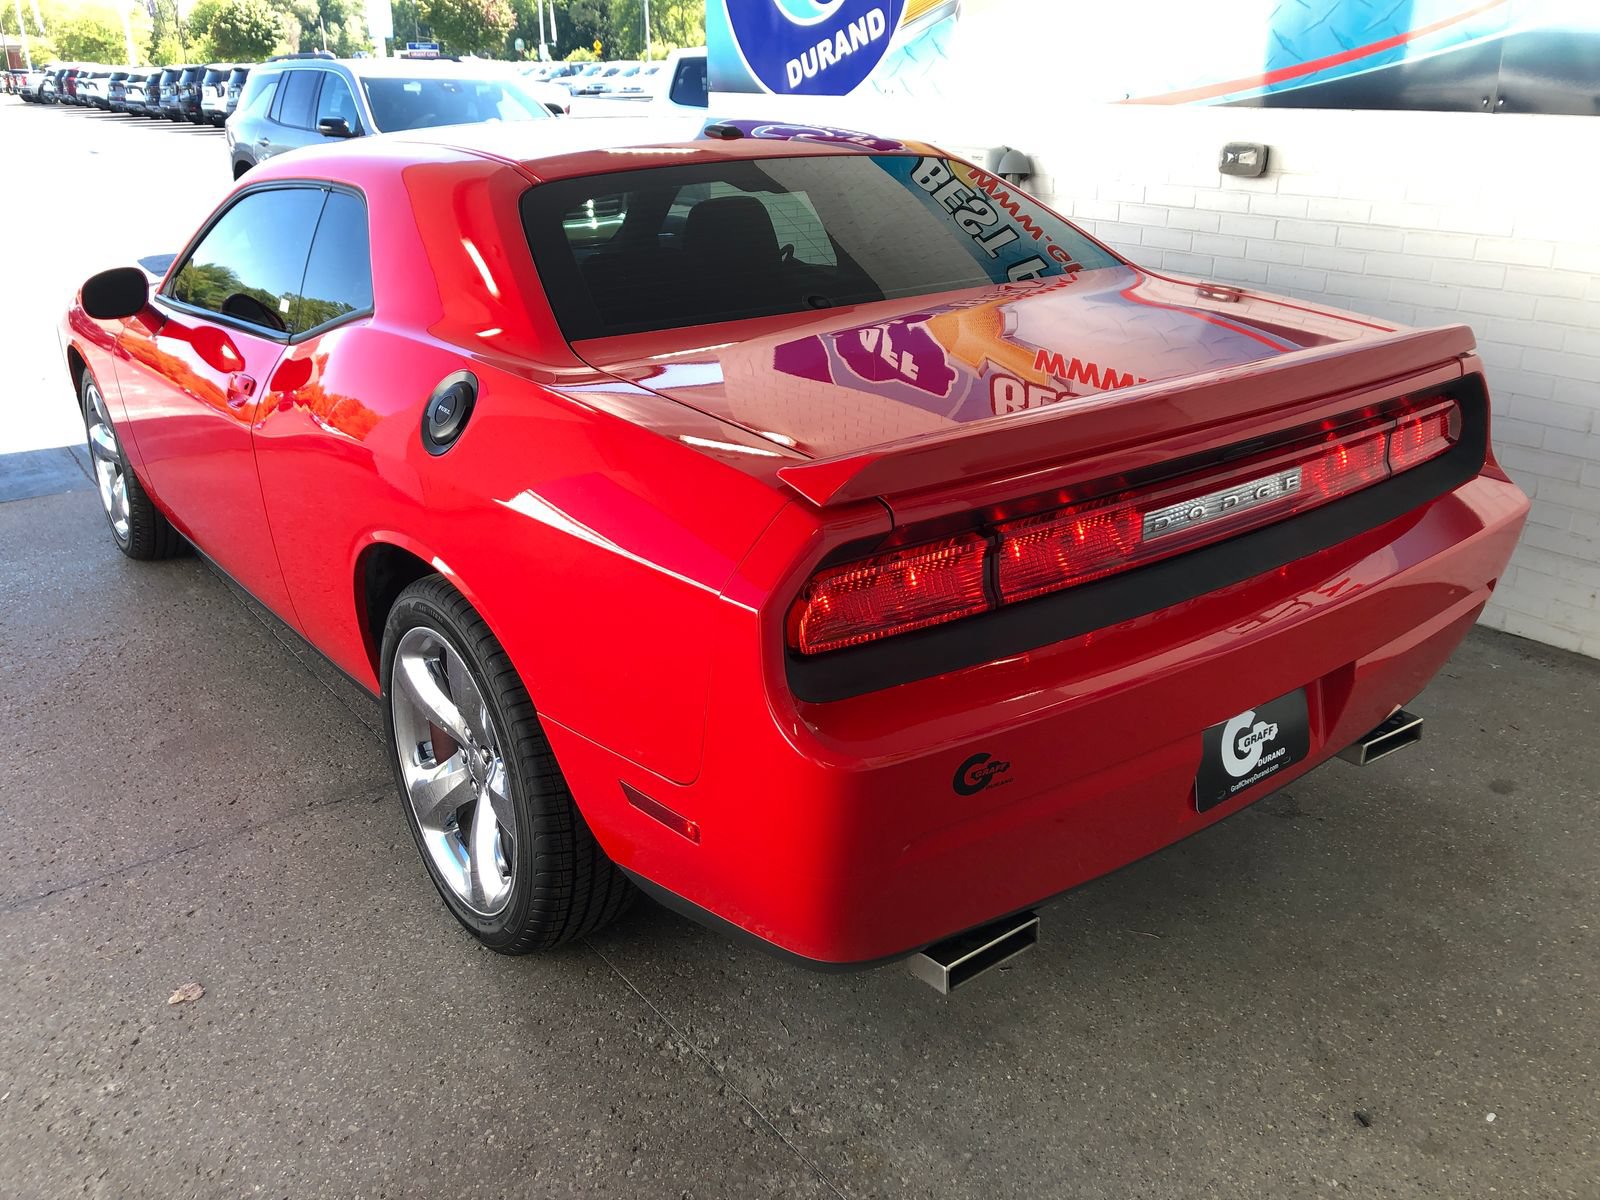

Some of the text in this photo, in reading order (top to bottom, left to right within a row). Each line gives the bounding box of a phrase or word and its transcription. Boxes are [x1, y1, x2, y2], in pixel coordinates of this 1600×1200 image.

[785, 7, 886, 89] DURAND
[438, 405, 451, 415] FUEL
[1150, 475, 1300, 533] DODGE
[1244, 725, 1275, 748] GRAFF
[1258, 747, 1286, 767] DURAND
[1230, 763, 1279, 793] GraffChevyDurand.com
